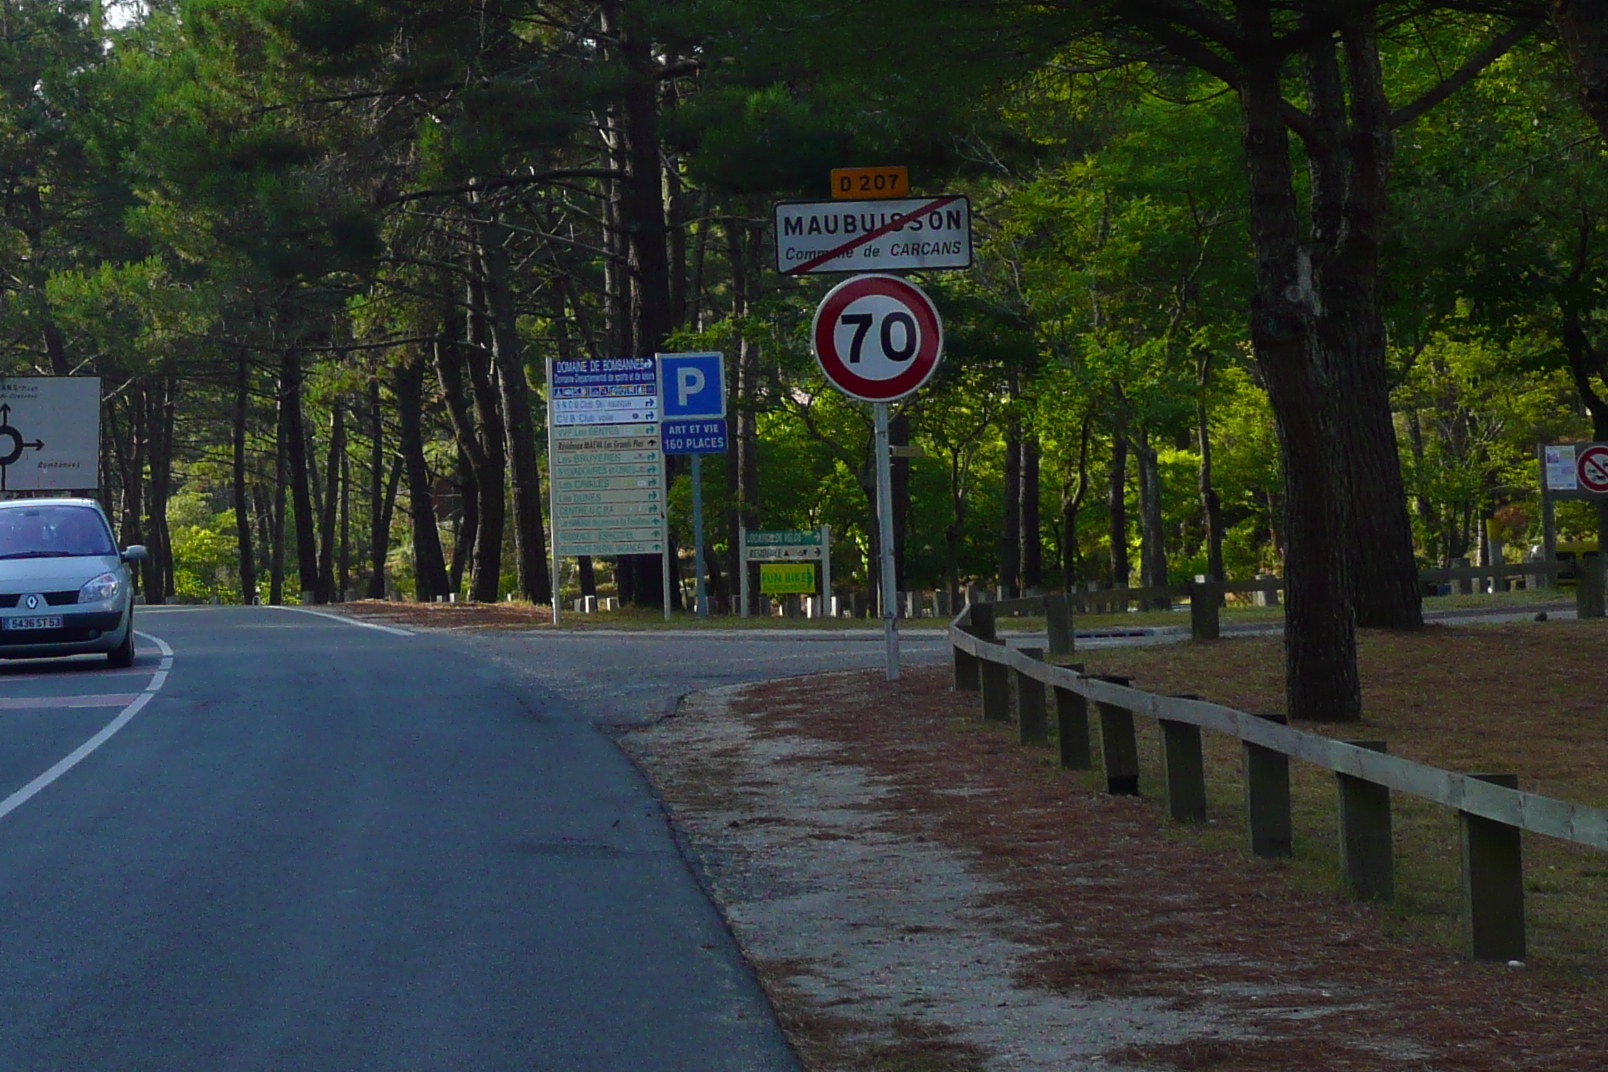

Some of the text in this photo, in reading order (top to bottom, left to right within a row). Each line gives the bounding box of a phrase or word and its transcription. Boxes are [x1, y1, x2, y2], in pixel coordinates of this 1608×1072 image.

[841, 174, 899, 192] D 207
[783, 209, 962, 237] MAUBUISSON
[786, 240, 962, 261] Commne de CARCANS
[841, 311, 917, 364] 70
[556, 360, 587, 373] DOMAINE
[590, 360, 600, 372] DE
[677, 367, 705, 406] P
[669, 423, 719, 435] ART ET VIE
[664, 436, 724, 450] 160 PLACES
[12, 618, 61, 628] 5436 ST 53
